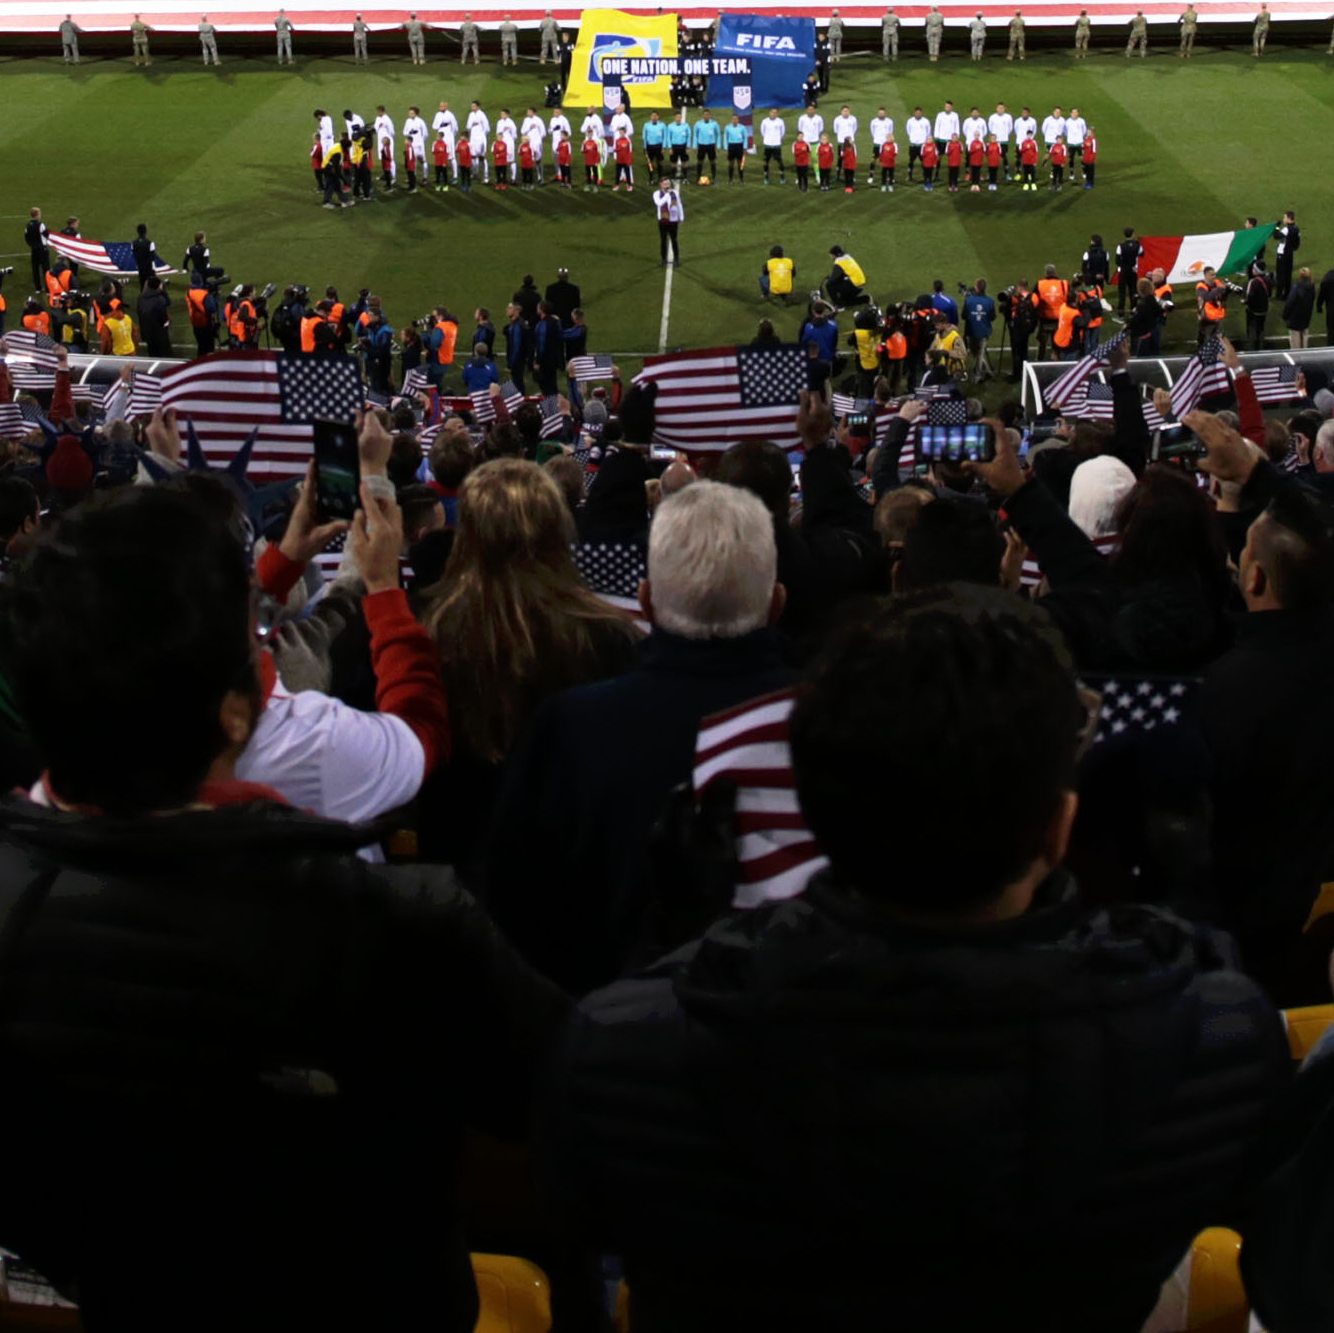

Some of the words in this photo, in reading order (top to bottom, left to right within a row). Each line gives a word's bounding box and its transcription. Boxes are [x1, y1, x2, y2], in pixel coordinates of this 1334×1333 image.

[736, 33, 796, 50] FIFA
[603, 59, 628, 74] ONE
[630, 59, 682, 75] NATION.
[683, 59, 710, 75] ONE
[712, 58, 751, 74] TEAM.
[604, 87, 621, 97] USA
[734, 87, 750, 97] USA
